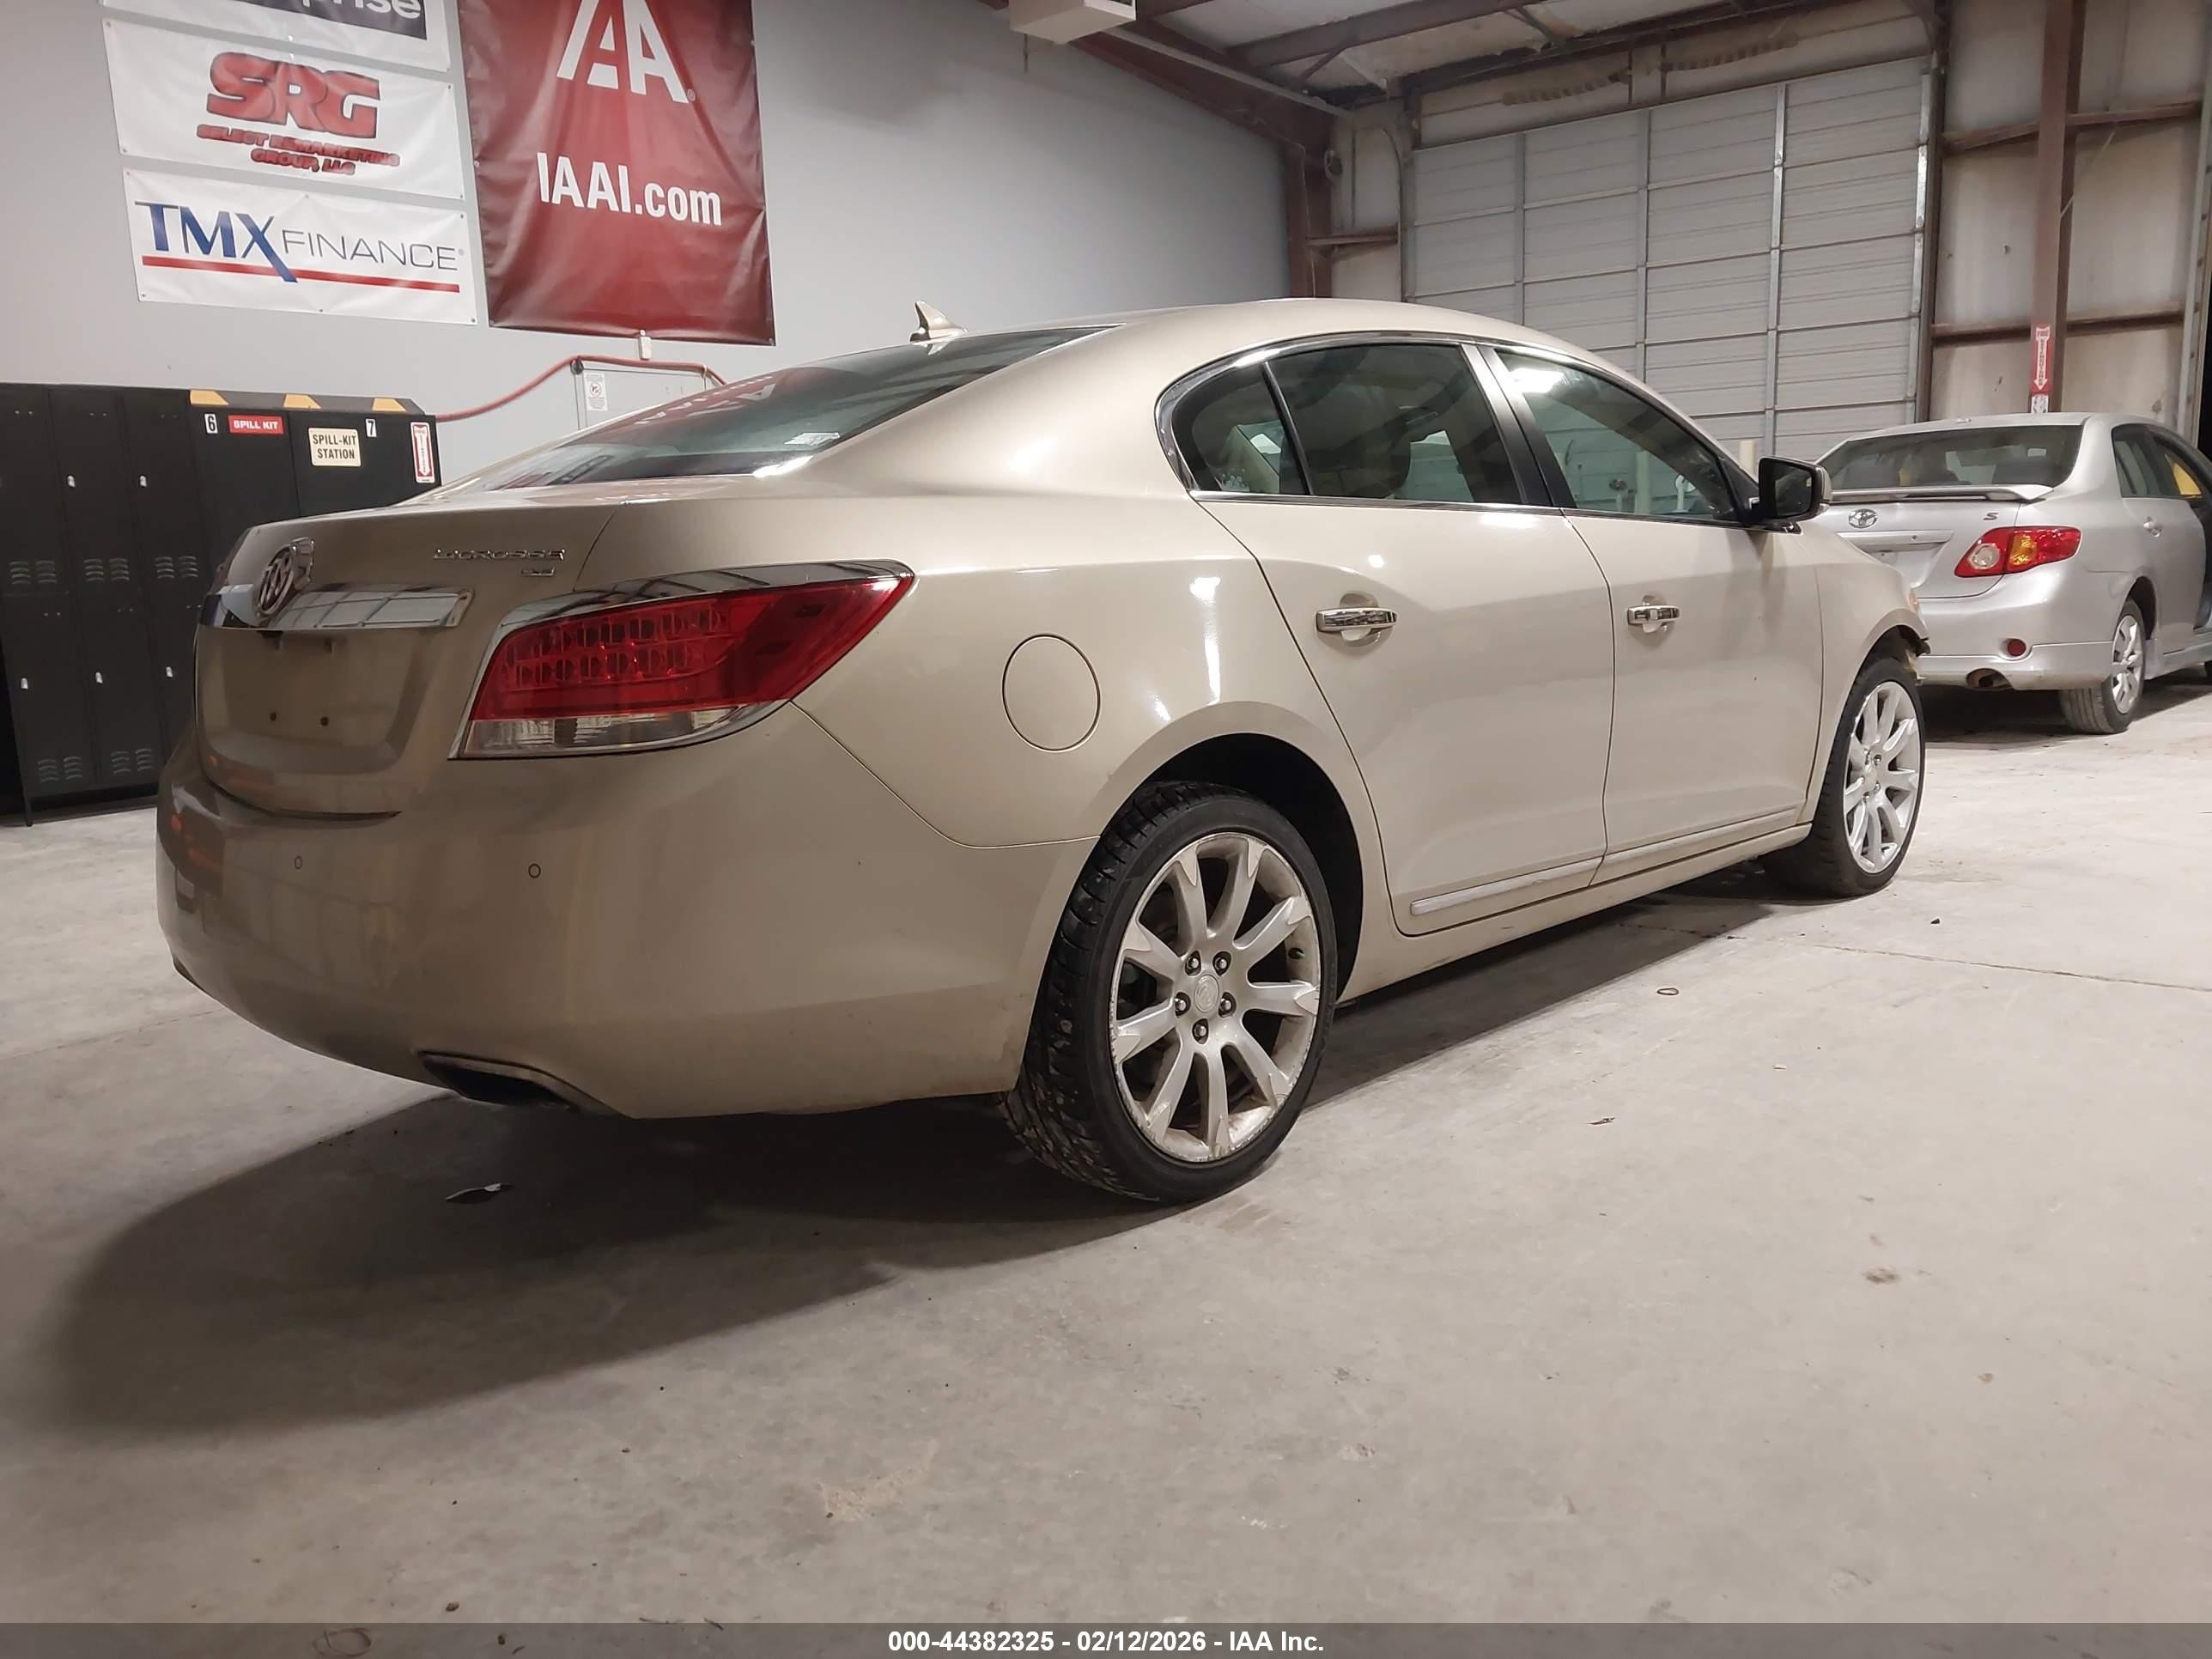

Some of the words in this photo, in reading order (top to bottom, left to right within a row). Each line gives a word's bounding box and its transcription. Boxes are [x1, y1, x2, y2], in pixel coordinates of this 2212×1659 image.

[206, 52, 380, 139] SRG
[322, 158, 356, 176] LLC
[537, 152, 722, 227] IAAI.com
[207, 416, 216, 432] 6
[234, 420, 262, 428] SPILL
[263, 421, 279, 429] KIT
[368, 420, 374, 435] 7
[313, 434, 356, 445] SPILL-KIT
[317, 448, 356, 459] STATION
